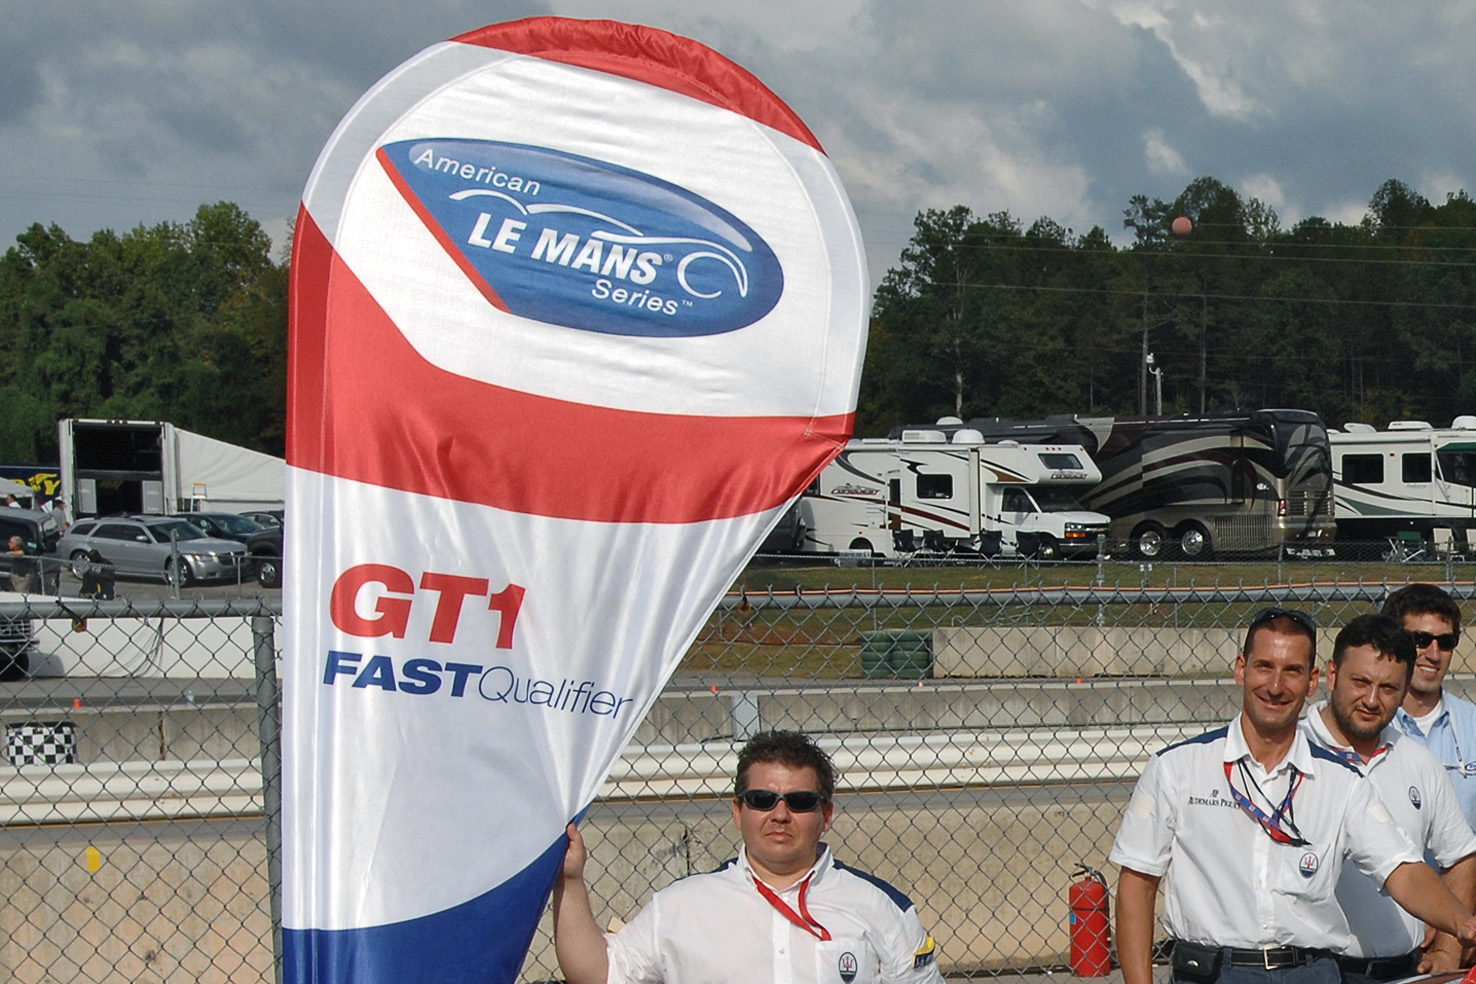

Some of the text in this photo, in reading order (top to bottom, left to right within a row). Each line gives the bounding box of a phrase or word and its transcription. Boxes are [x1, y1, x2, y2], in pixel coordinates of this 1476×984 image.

[413, 148, 541, 196] American
[468, 212, 527, 253] LE
[330, 563, 526, 650] GT1
